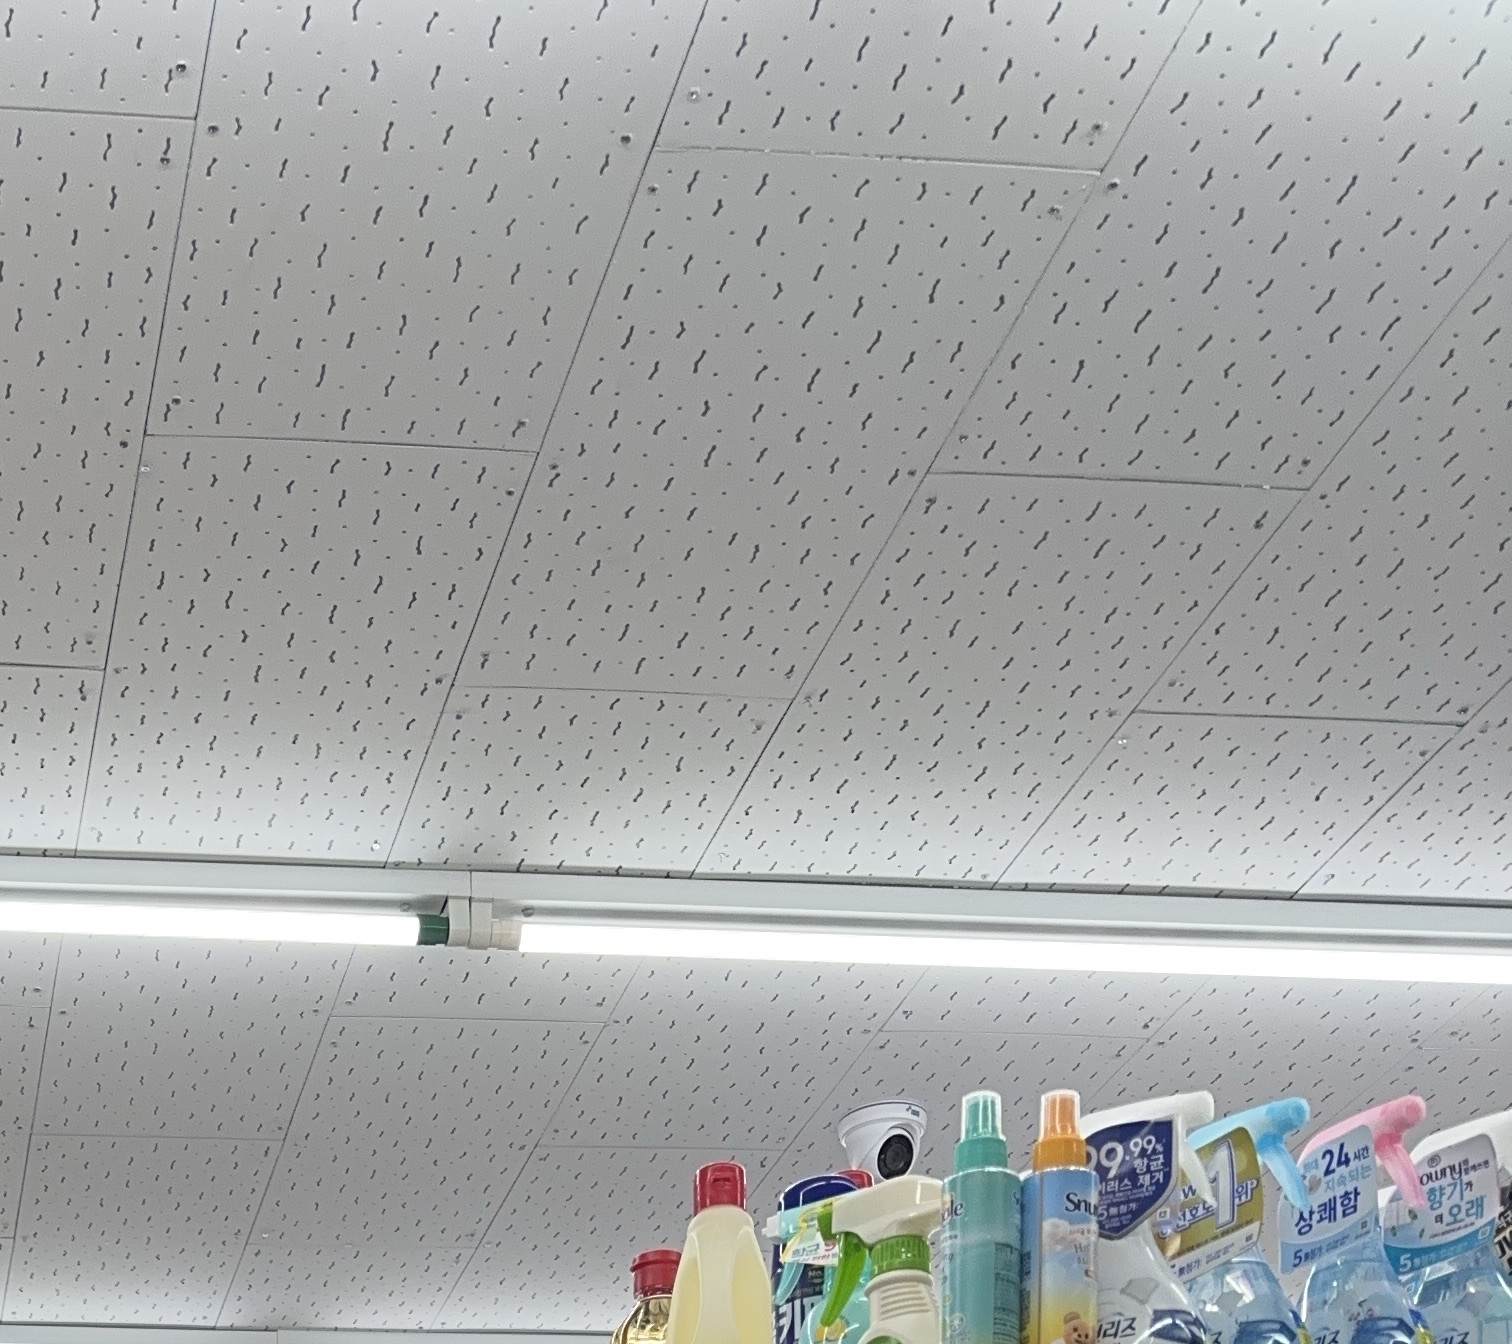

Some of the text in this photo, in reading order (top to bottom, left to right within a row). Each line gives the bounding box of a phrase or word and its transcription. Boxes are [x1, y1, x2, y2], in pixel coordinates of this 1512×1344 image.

[1133, 1155, 1165, 1174] 항균
[1324, 1163, 1373, 1194] 지속되는
[1138, 1173, 1165, 1189] 제거
[1426, 1177, 1474, 1211] 향기가
[1294, 1185, 1362, 1237] 상쾌함
[1434, 1195, 1486, 1228] 더 오래
